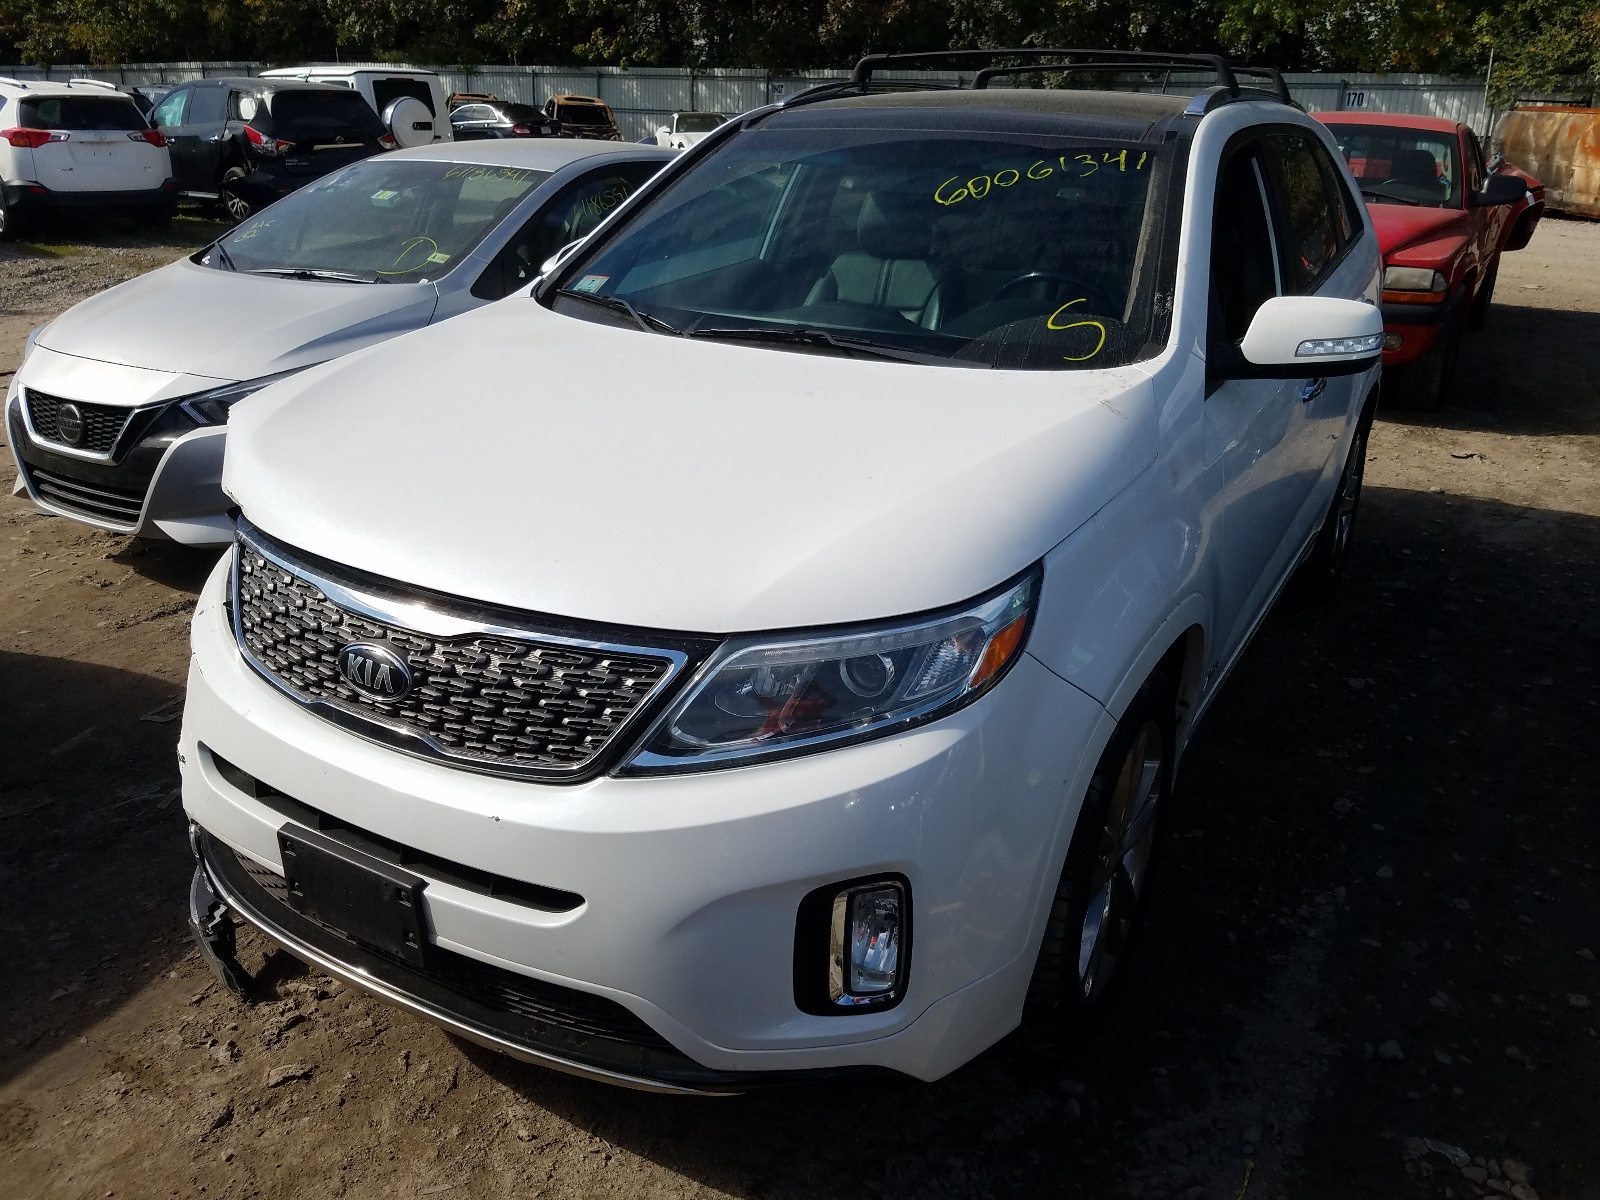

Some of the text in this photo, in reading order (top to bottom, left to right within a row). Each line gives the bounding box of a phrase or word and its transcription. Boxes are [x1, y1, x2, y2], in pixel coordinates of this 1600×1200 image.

[1346, 92, 1365, 107] 170
[934, 149, 1147, 206] 60061341
[347, 652, 394, 694] KIA
